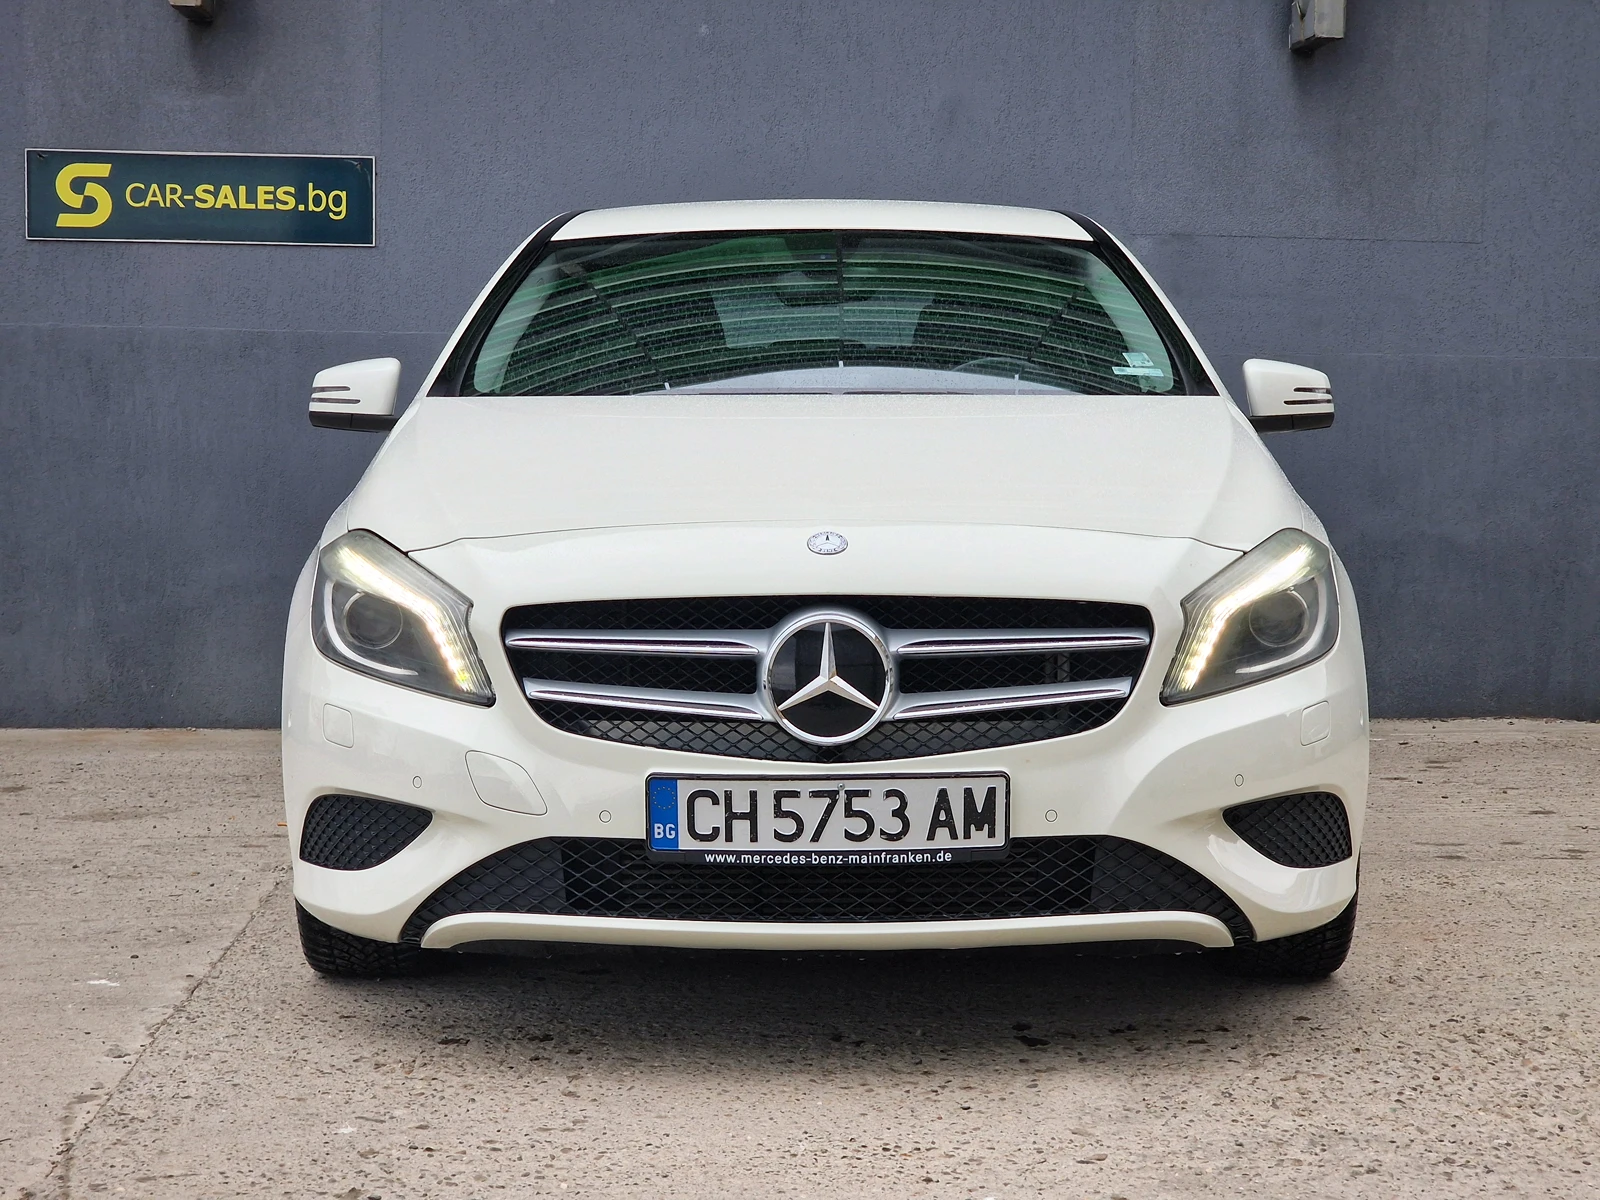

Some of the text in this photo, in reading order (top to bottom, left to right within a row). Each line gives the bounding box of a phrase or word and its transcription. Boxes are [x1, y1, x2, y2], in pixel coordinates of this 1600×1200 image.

[125, 182, 348, 221] CAR-SALES.bg
[686, 786, 997, 843] CH 5753 AM
[653, 822, 676, 839] BG
[704, 850, 953, 866] www.mercedes-benz-mainfranken.de
